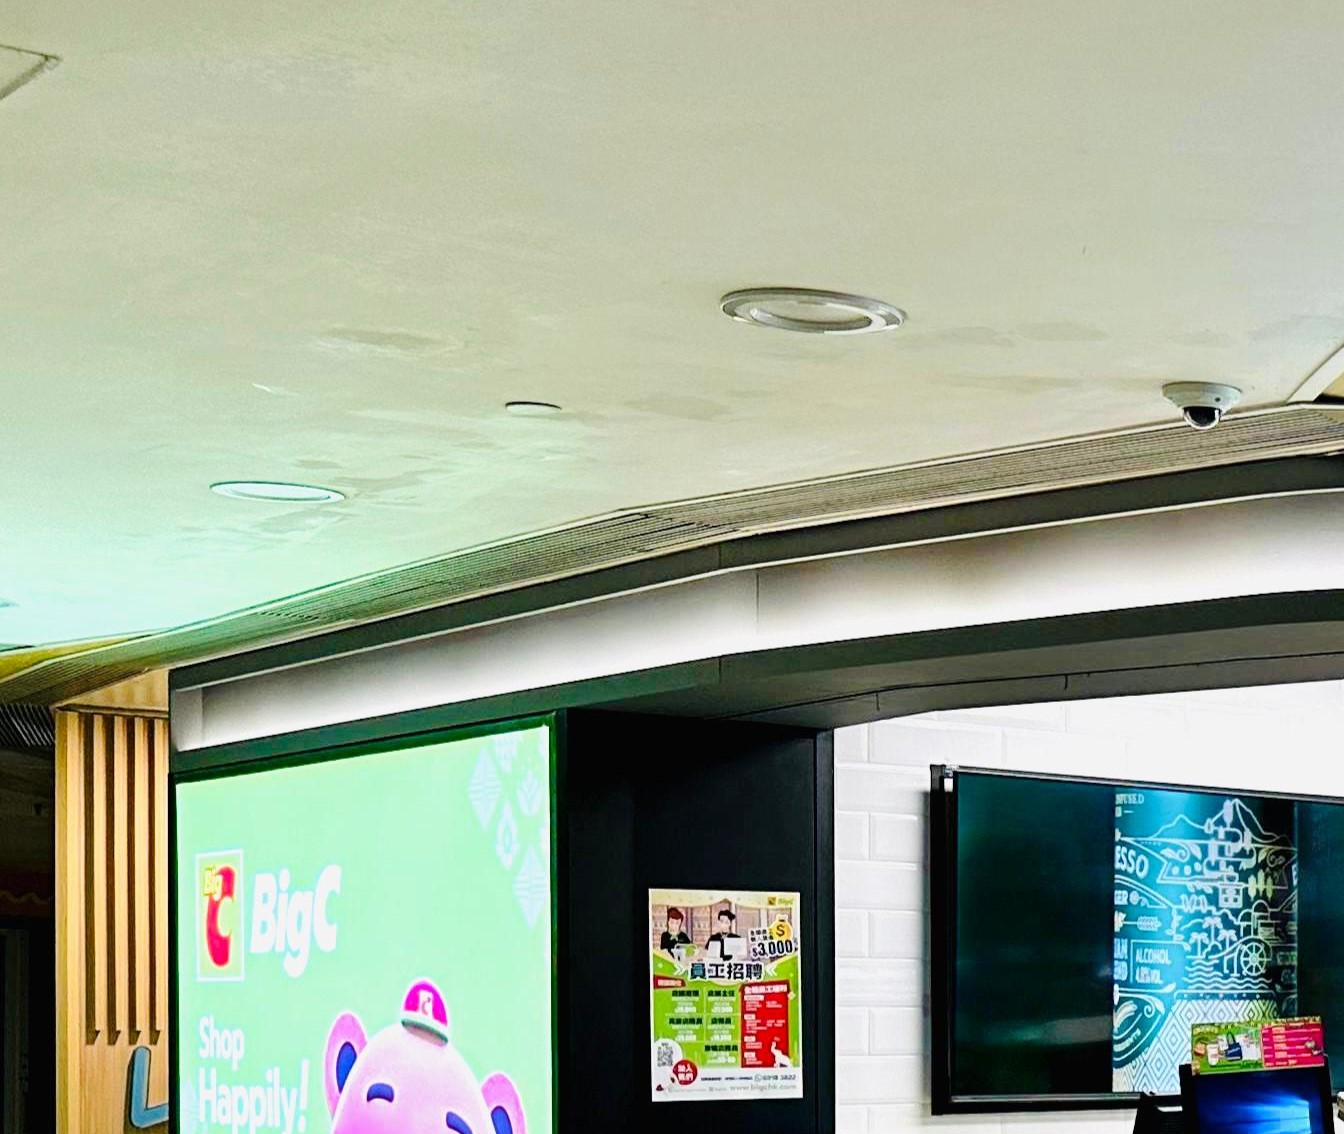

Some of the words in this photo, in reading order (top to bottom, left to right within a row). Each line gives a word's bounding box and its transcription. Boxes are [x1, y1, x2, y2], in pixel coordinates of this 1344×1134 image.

[250, 864, 341, 978] BigC
[752, 939, 793, 959] $3,000
[690, 962, 764, 980] 員工招聘
[199, 1015, 245, 1071] Shop
